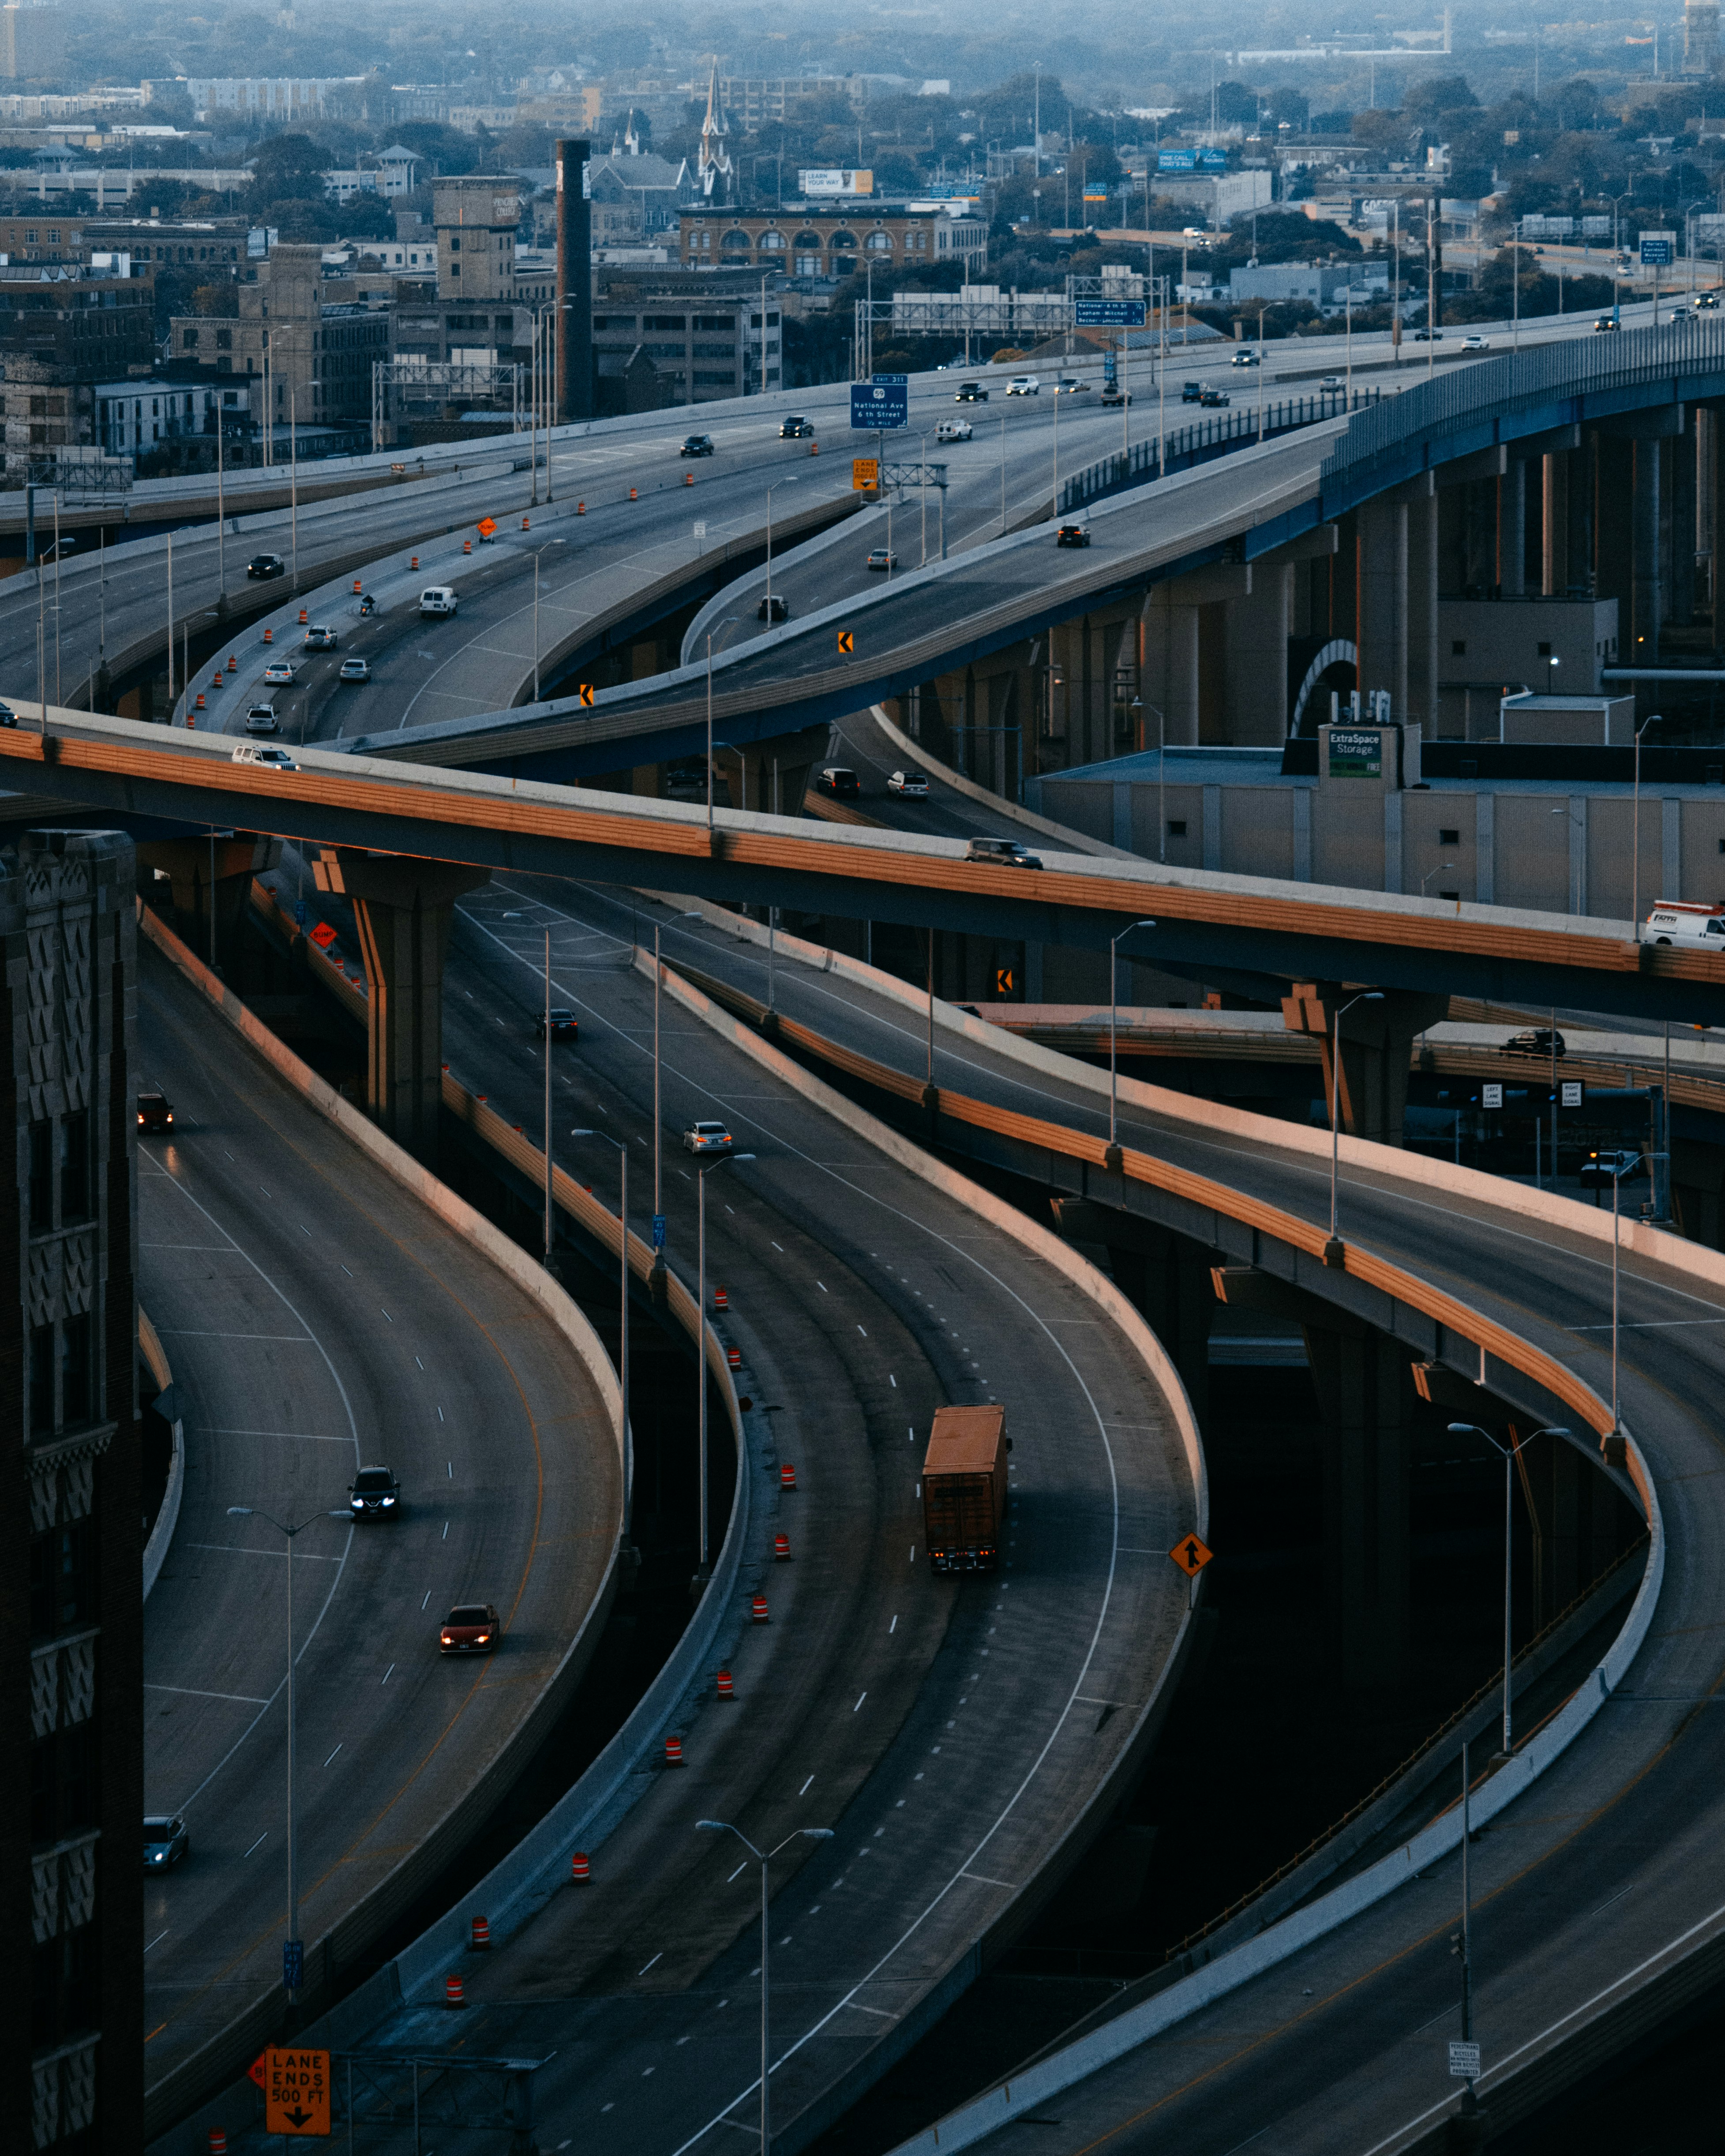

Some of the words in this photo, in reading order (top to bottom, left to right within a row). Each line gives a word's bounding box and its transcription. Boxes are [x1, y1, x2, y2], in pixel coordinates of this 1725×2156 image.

[1330, 733, 1379, 745] ExtraSpace
[1337, 744, 1373, 756] Storage
[1367, 762, 1380, 771] FREE
[274, 2054, 322, 2069] LANE
[274, 2072, 323, 2087] ENDS
[273, 2089, 300, 2103] 500
[308, 2090, 323, 2104] FT
